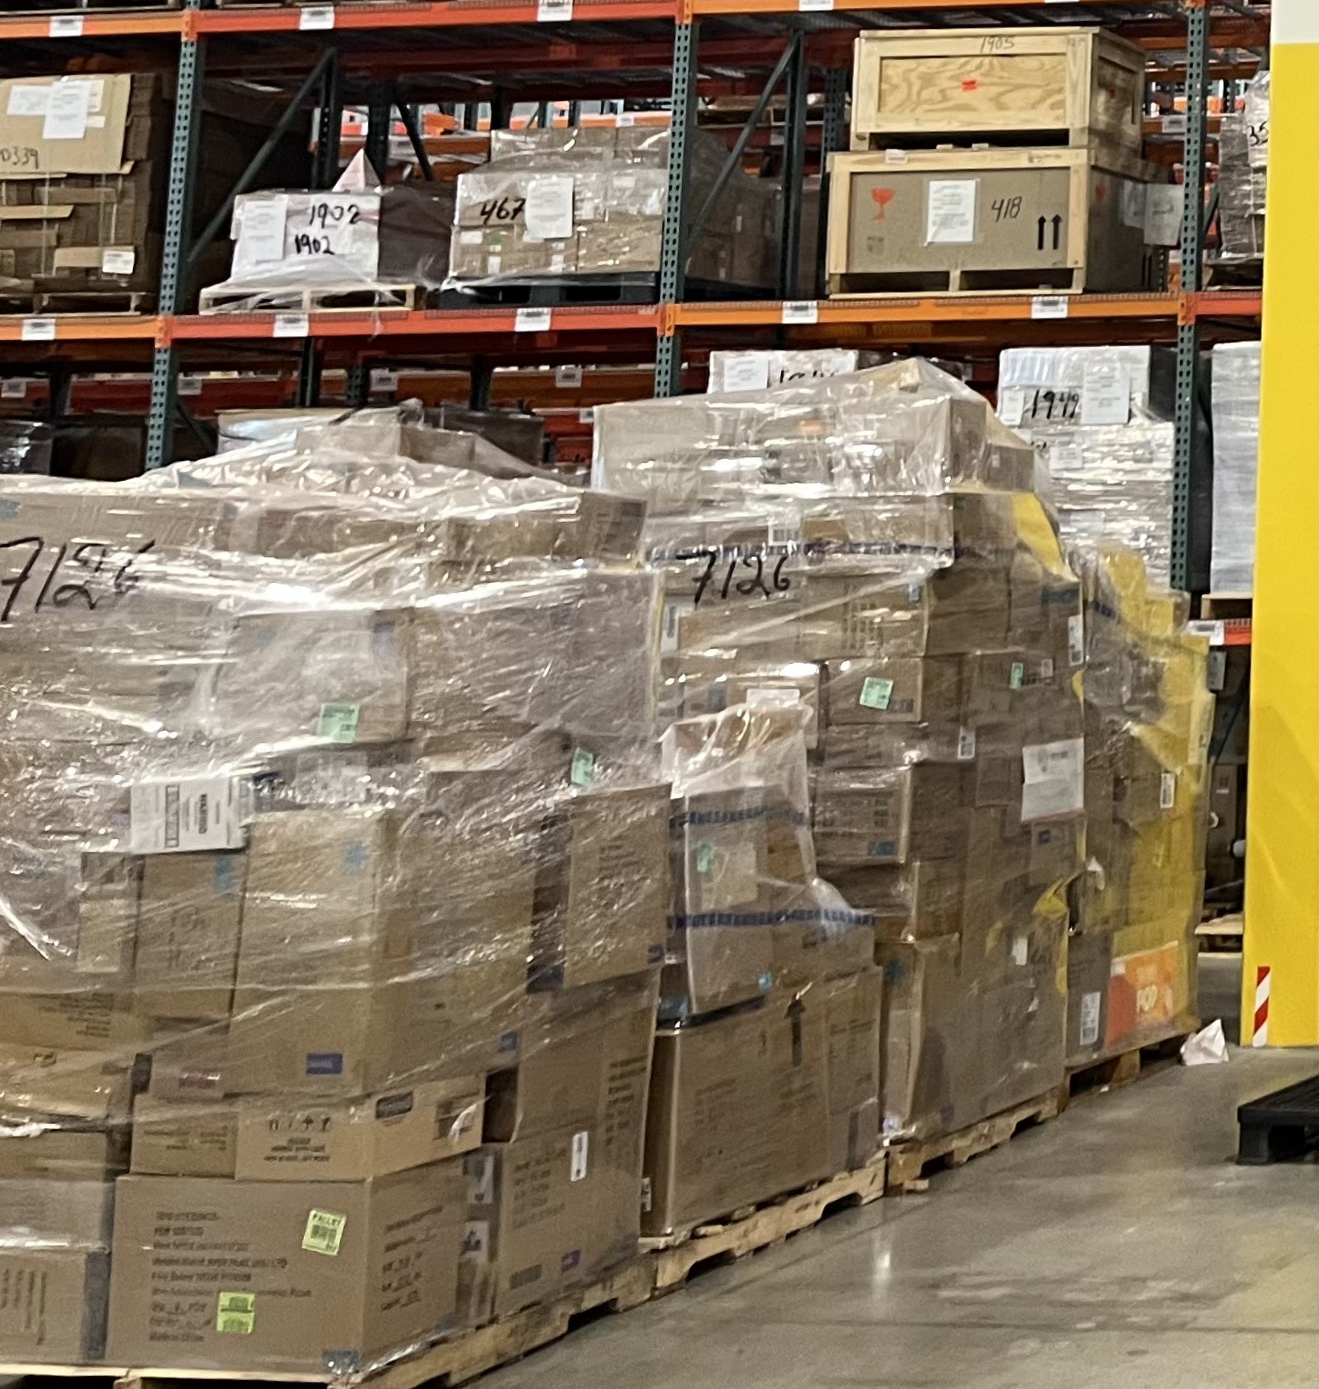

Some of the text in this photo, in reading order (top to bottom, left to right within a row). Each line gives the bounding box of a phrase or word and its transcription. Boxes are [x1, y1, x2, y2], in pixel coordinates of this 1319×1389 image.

[309, 202, 361, 229] 1902
[480, 197, 526, 226] 467
[991, 195, 1023, 223] 418
[294, 233, 335, 256] 1902
[675, 549, 792, 608] 7126
